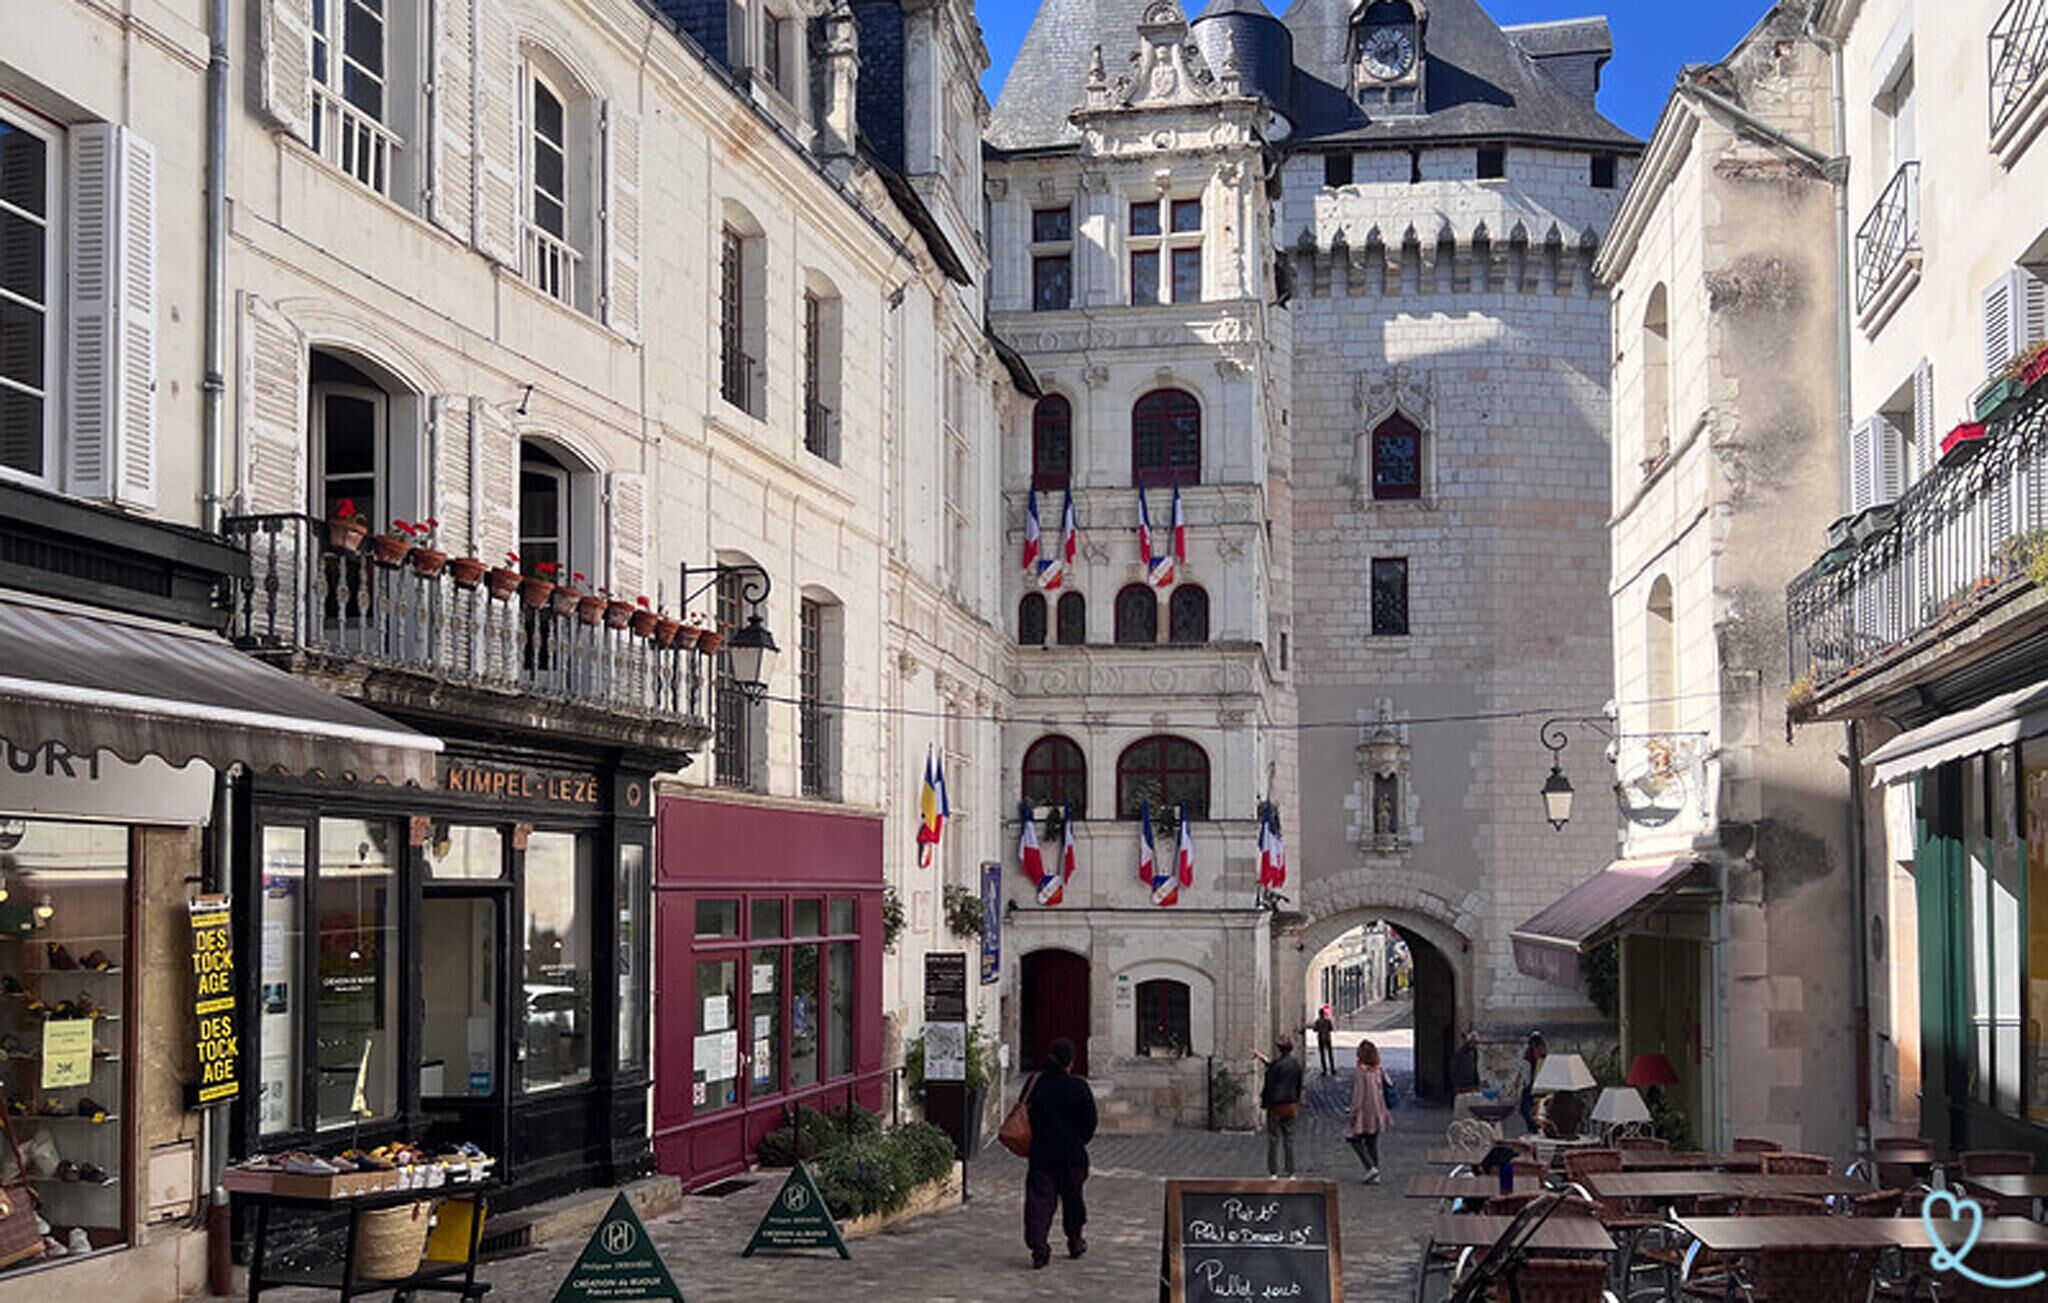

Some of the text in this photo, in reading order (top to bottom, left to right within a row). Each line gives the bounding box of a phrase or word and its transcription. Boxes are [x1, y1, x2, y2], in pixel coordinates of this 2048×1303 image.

[449, 767, 598, 803] KIMPEL LEZÉ
[196, 929, 227, 951] DES
[192, 950, 234, 974] TOCK
[199, 972, 229, 995] AGE
[201, 1016, 232, 1040] DES
[197, 1036, 239, 1062] TOCK
[203, 1059, 234, 1083] AGE
